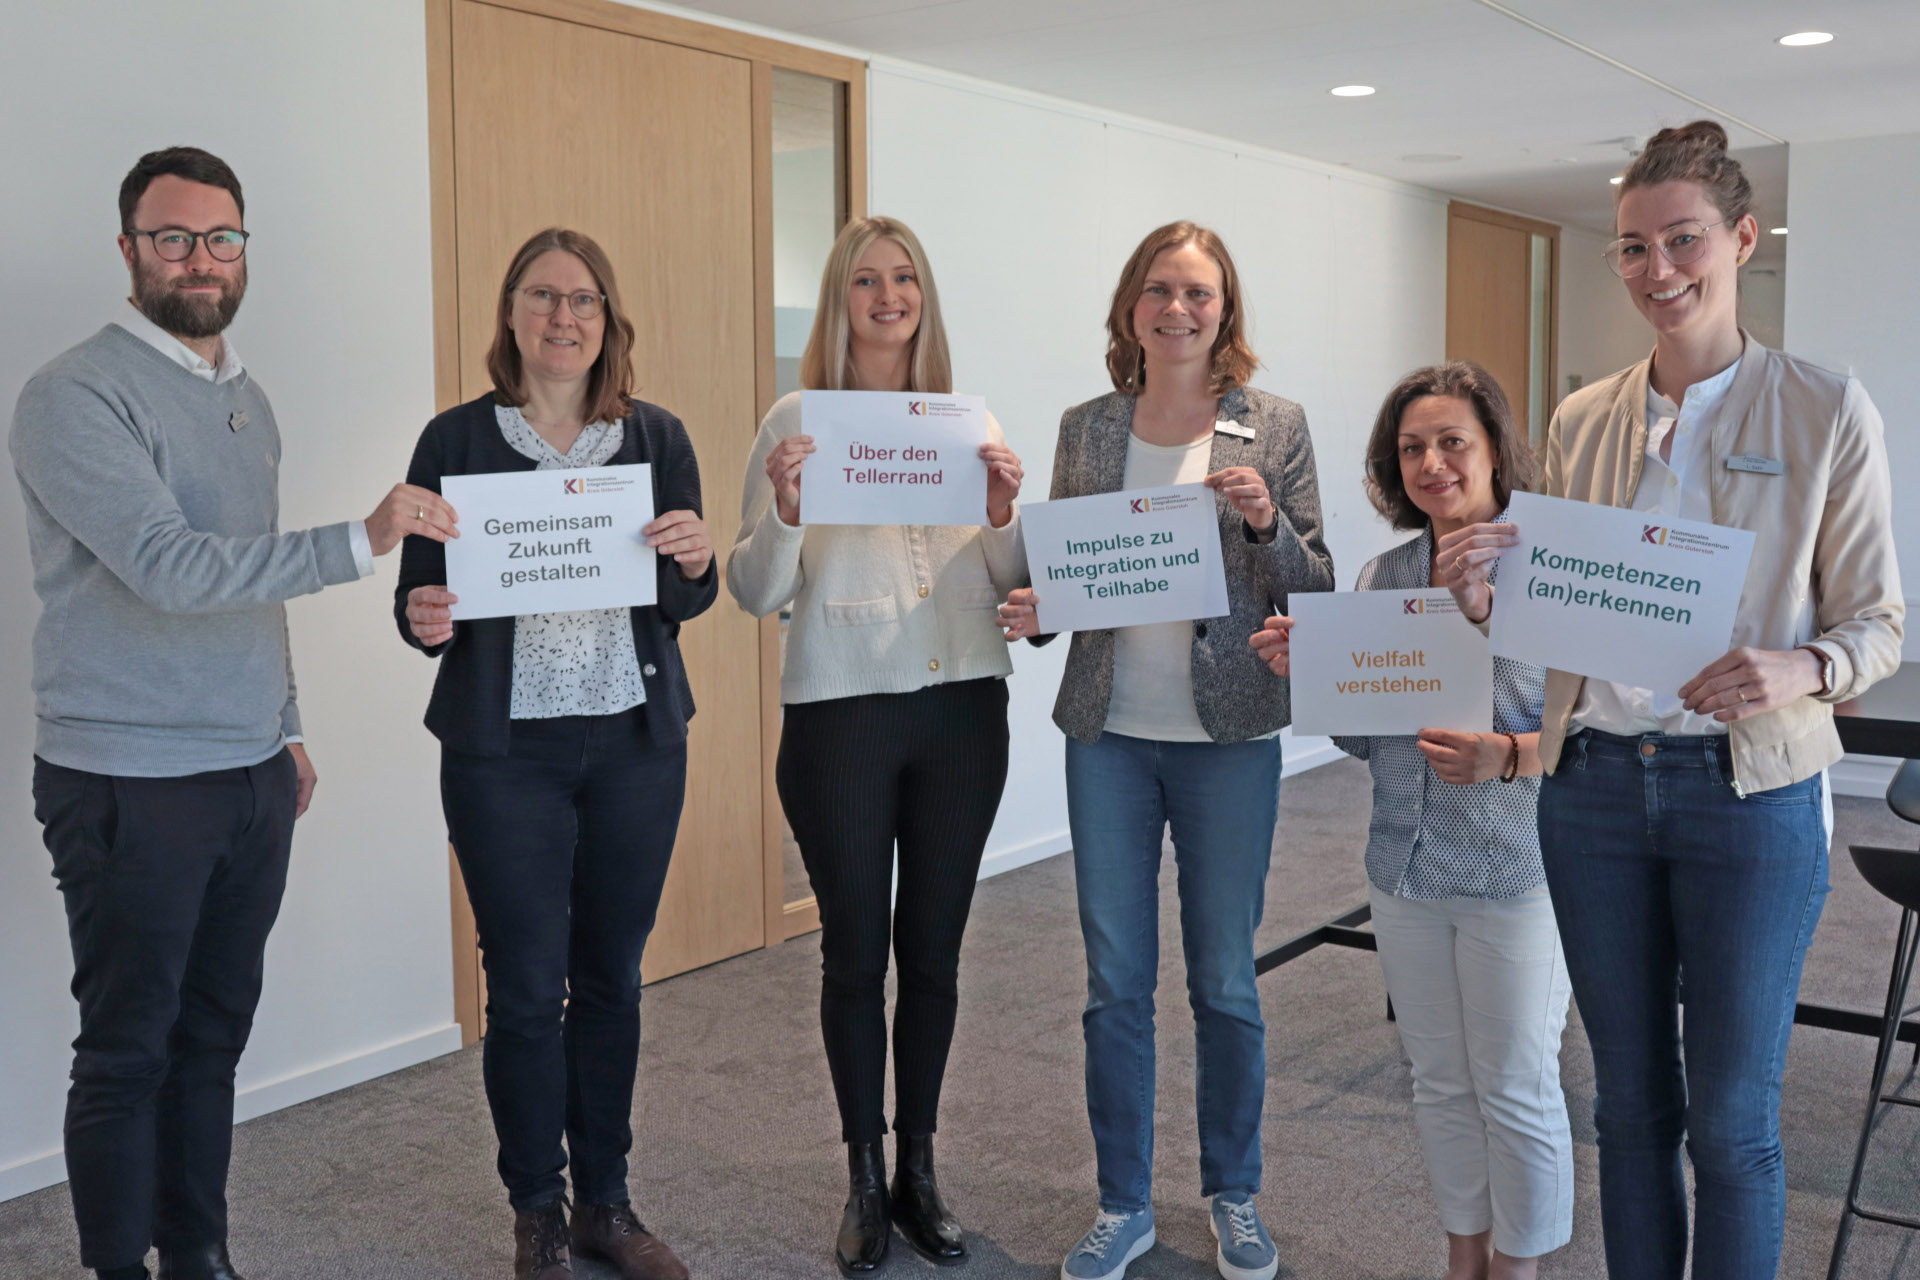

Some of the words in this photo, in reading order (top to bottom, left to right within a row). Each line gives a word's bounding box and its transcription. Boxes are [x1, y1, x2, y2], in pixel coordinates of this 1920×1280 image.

[849, 441, 897, 460] Über
[902, 445, 937, 461] den
[842, 467, 943, 485] Tellerrand
[484, 515, 612, 535] Gemeinsam
[1671, 529, 1709, 541] Kommunales
[508, 538, 592, 559] Zukunft
[1067, 534, 1144, 556] Impulse
[1150, 531, 1173, 545] zu
[1668, 542, 1683, 550] Kreis
[1670, 535, 1730, 550] Integrationszentrum
[1047, 556, 1156, 580] Integration
[1162, 548, 1199, 567] und
[1530, 546, 1701, 595] Kompetenzen
[500, 563, 601, 588] gestalten
[1083, 578, 1169, 599] Teilhabe
[1528, 576, 1692, 625] (an)erkennen
[1351, 650, 1426, 668] Vielfalt
[1336, 675, 1442, 694] verstehen
